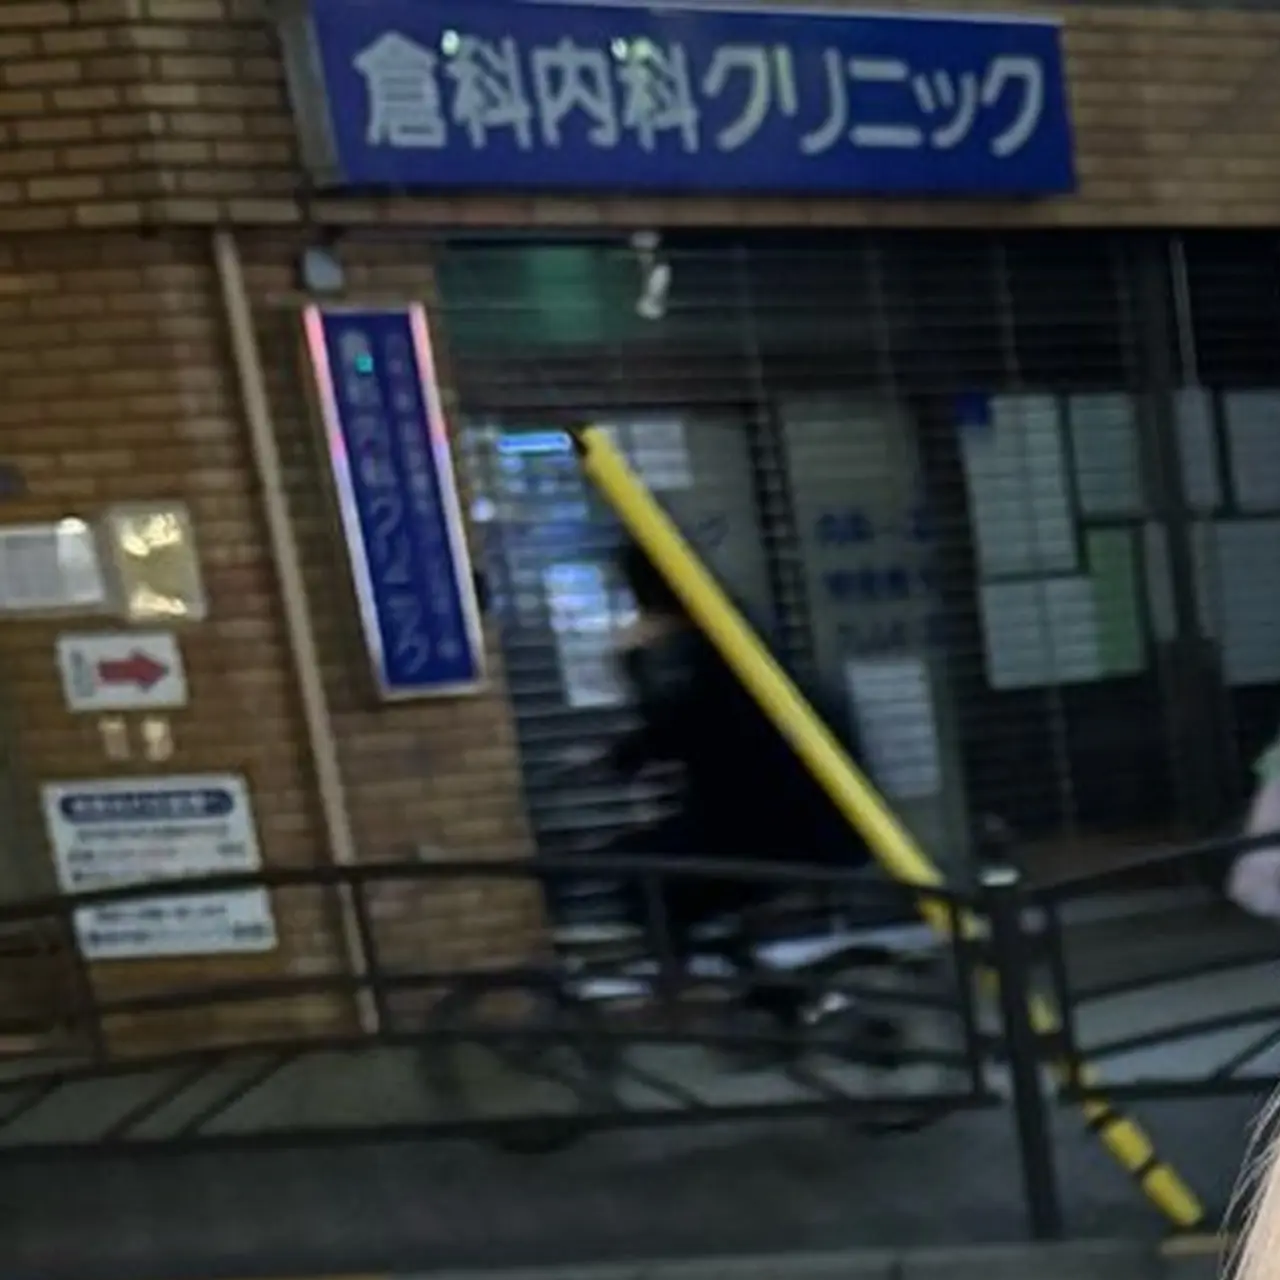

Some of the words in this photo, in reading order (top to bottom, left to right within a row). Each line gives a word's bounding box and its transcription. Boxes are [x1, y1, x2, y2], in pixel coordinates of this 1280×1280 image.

[353, 30, 1045, 158] 倉科内科クリニック
